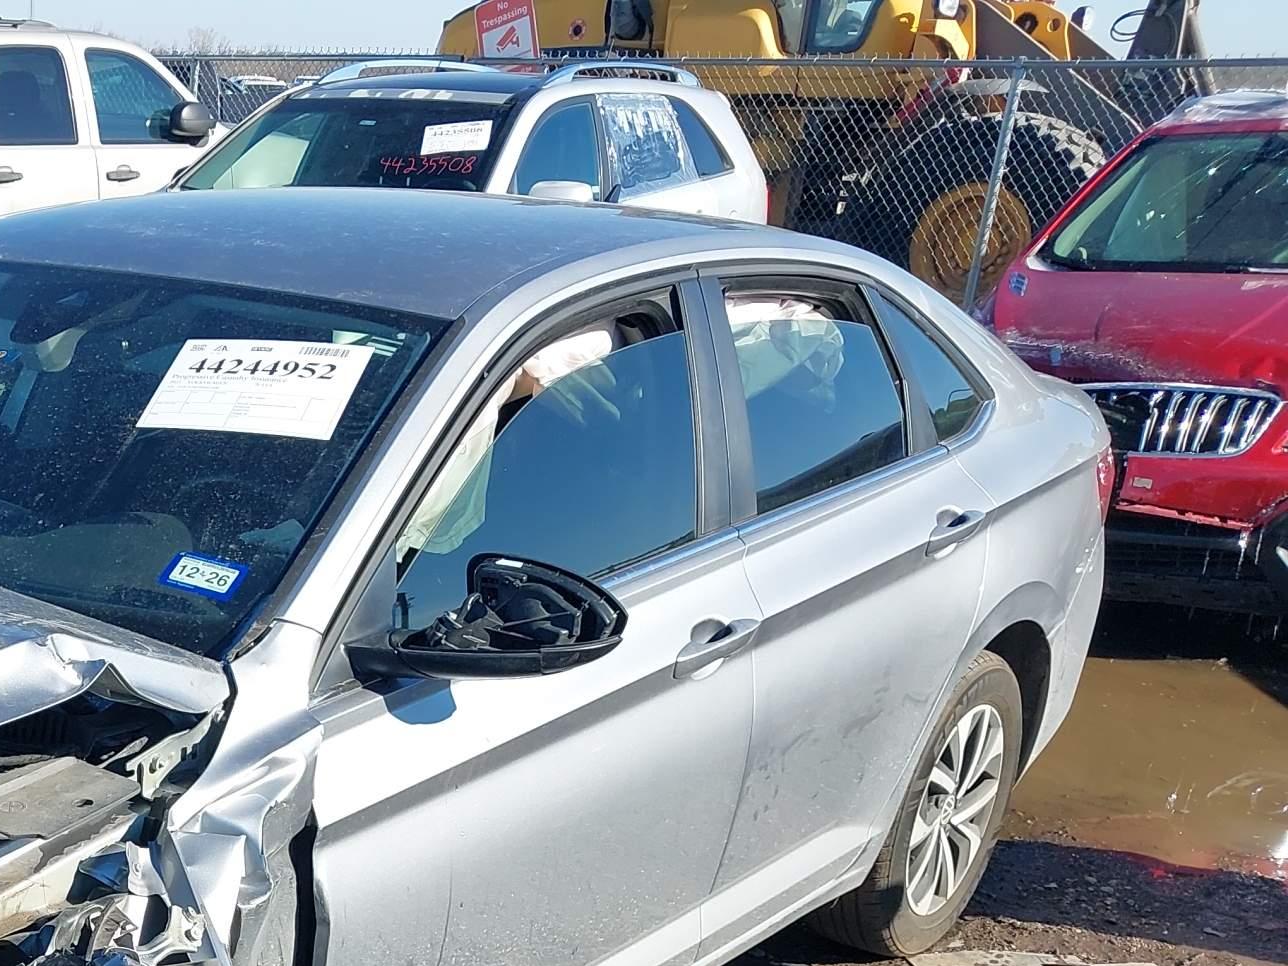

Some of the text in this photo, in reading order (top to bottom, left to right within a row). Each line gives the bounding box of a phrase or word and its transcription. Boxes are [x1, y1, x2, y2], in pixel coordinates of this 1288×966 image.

[497, 1, 509, 12] No
[481, 6, 528, 29] Trespassing
[380, 156, 477, 175] 44235508
[189, 358, 337, 380] 44244952
